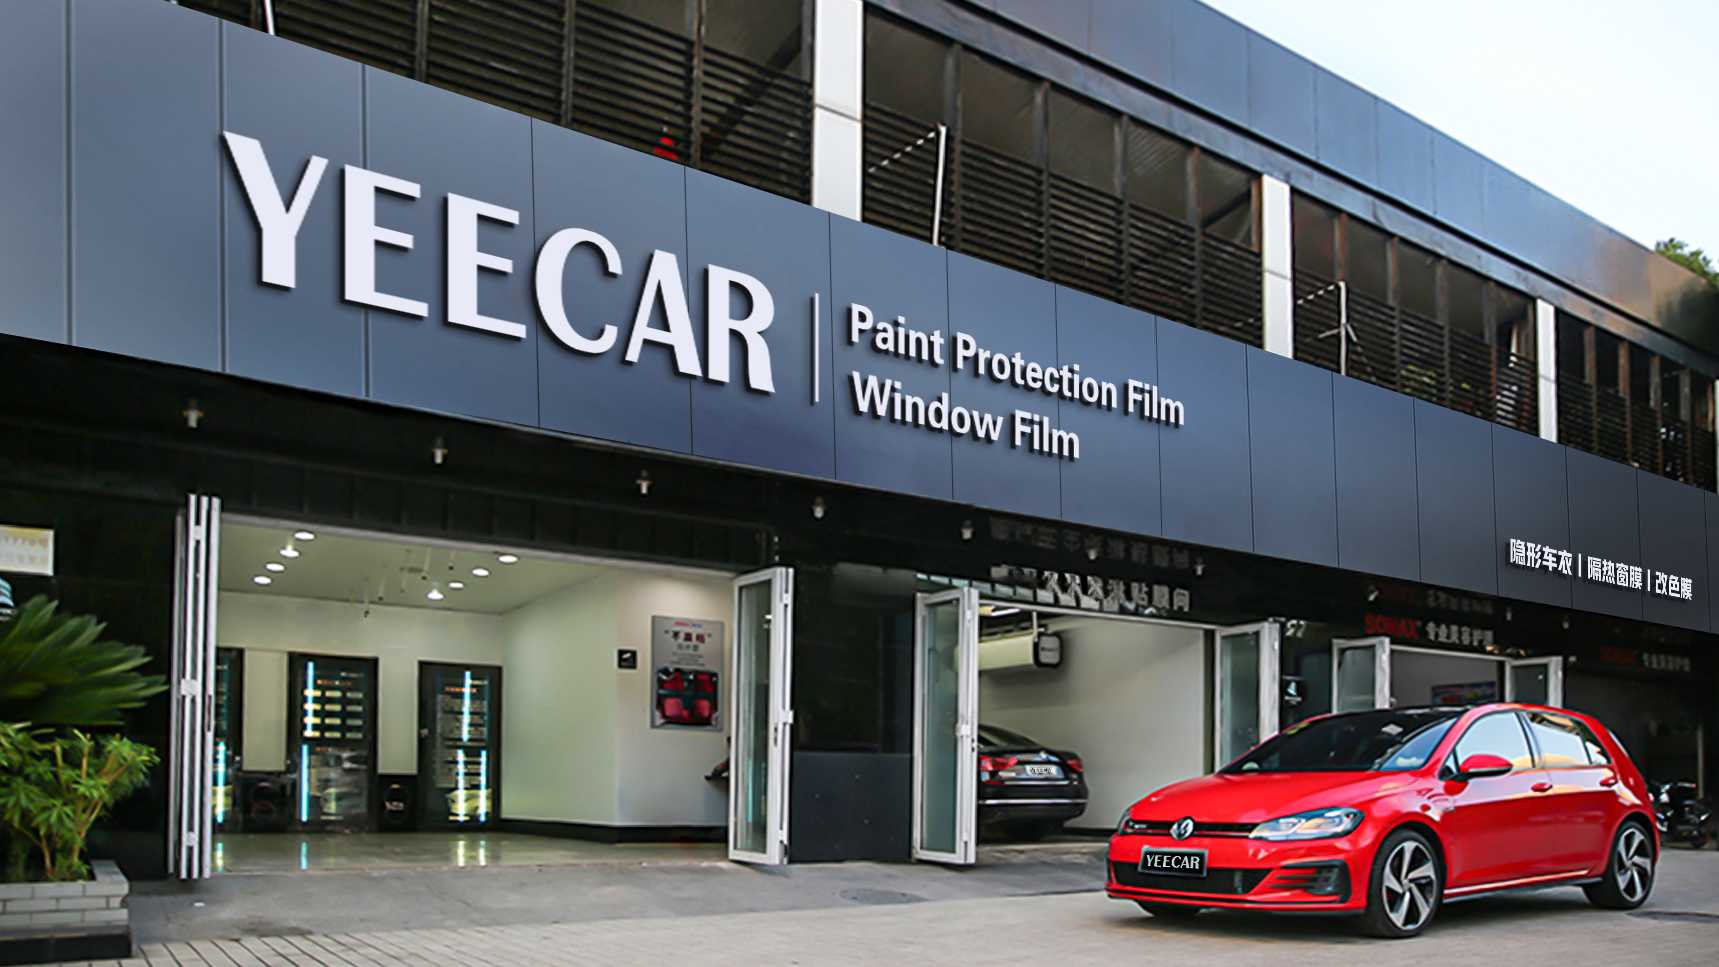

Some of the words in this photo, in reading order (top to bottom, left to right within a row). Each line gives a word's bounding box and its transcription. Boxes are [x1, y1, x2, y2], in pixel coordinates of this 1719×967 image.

[222, 130, 776, 394] YEECAR
[850, 302, 945, 365] Paint
[956, 331, 1118, 409] Protection
[1128, 378, 1185, 426] Film
[852, 370, 1004, 442] Window
[1014, 409, 1080, 459] Film
[1509, 537, 1573, 576] 隐形车衣
[1587, 555, 1643, 591] 隔热窗膜
[1655, 570, 1693, 601] 改色膜
[1146, 854, 1200, 870] YEECAR
